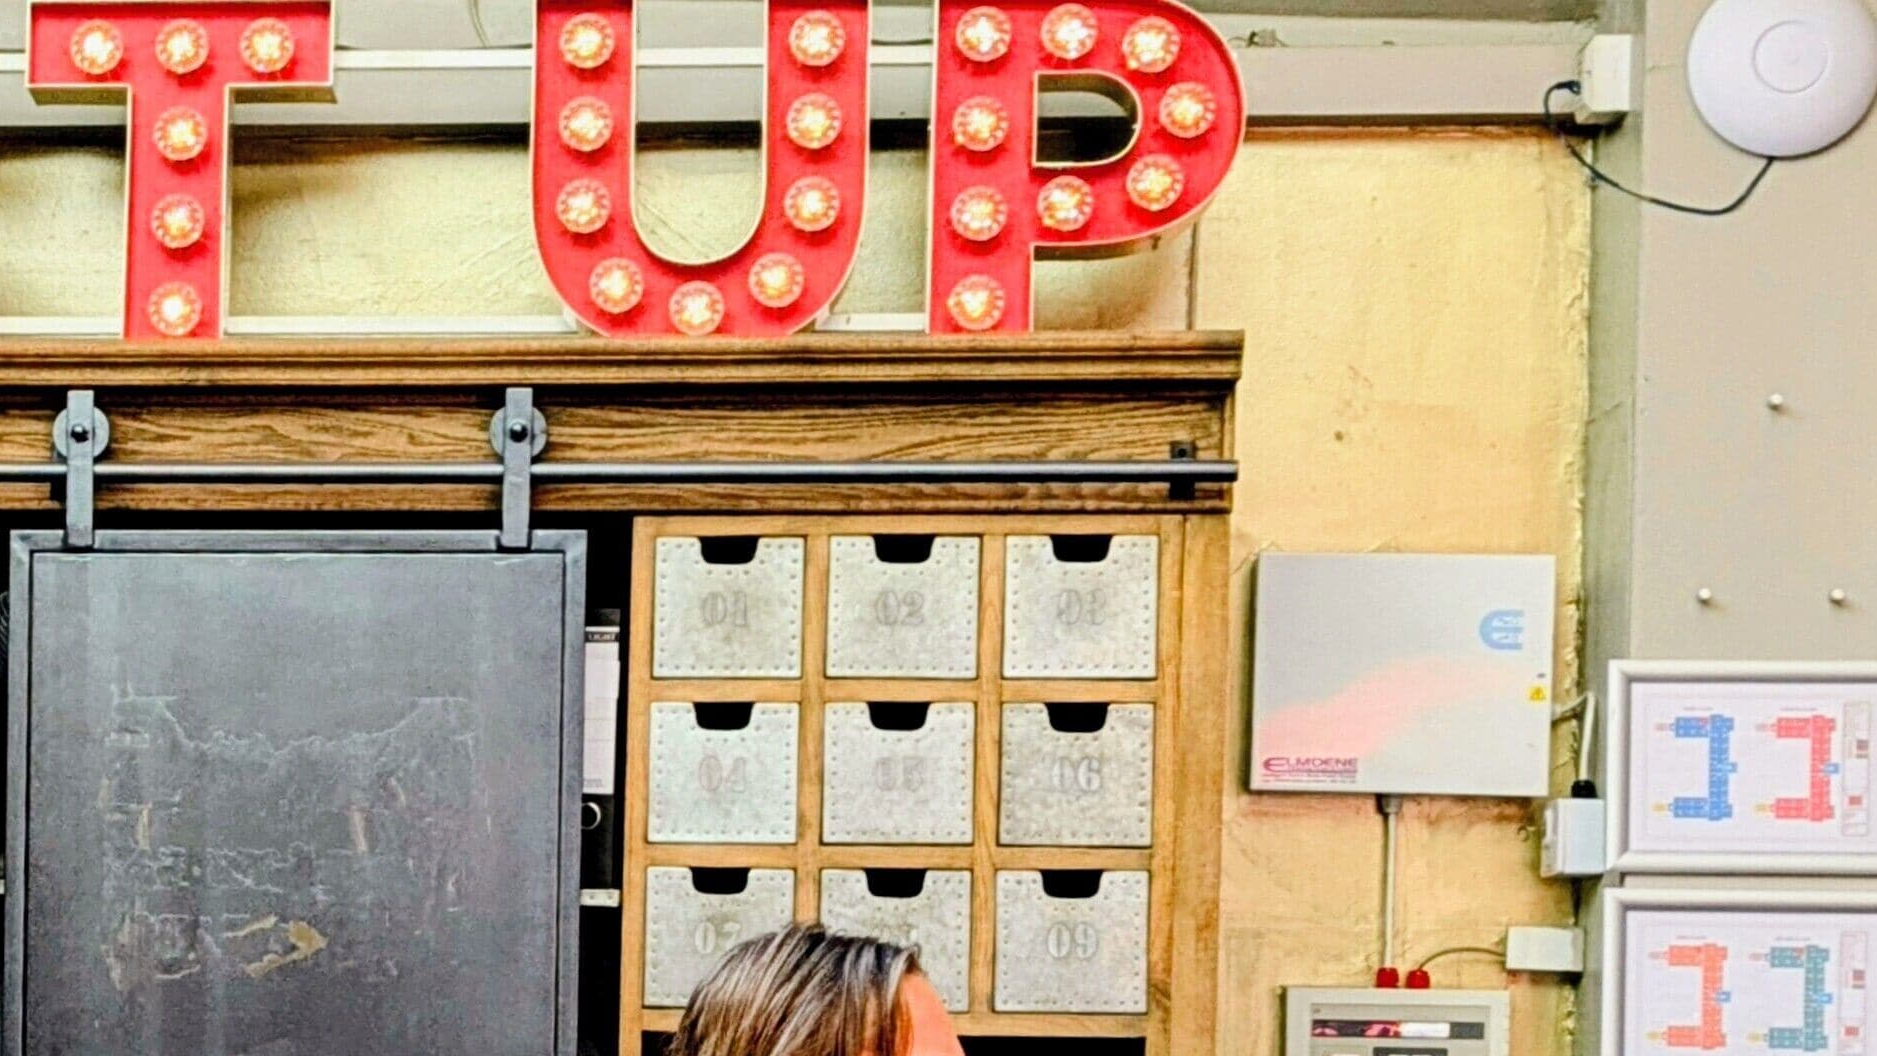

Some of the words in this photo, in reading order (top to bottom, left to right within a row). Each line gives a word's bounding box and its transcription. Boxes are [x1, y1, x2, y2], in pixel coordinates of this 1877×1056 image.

[531, 0, 1245, 336] UP
[699, 591, 749, 628] 01
[875, 590, 923, 626] 02
[698, 756, 747, 793] 04
[1052, 757, 1102, 793] 06
[1046, 921, 1099, 960] 09
